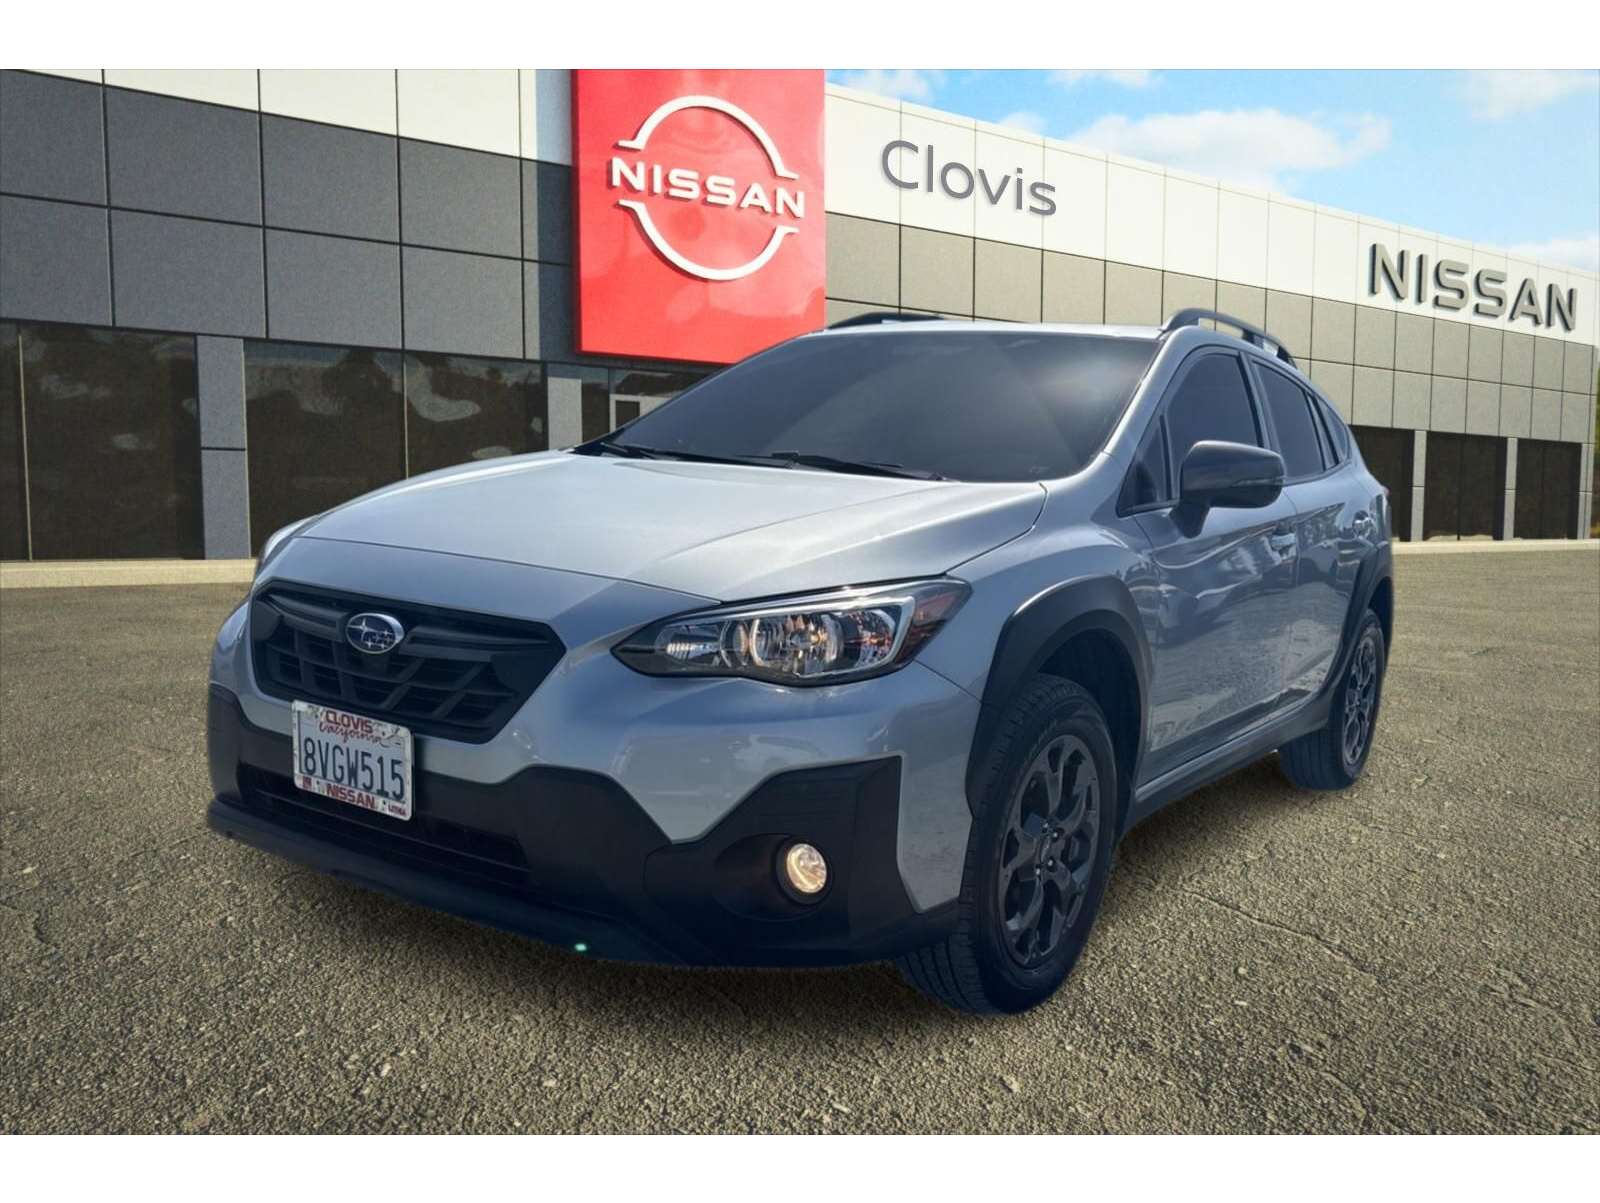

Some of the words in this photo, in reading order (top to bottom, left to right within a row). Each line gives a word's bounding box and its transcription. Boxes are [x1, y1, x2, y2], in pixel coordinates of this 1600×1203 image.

[611, 155, 804, 218] NISSAN
[881, 140, 1057, 216] Clovis
[1369, 243, 1577, 331] NISSAN
[326, 710, 373, 734] CLOVIS
[304, 737, 405, 801] 8VGW515
[327, 783, 375, 809] NISSAN
